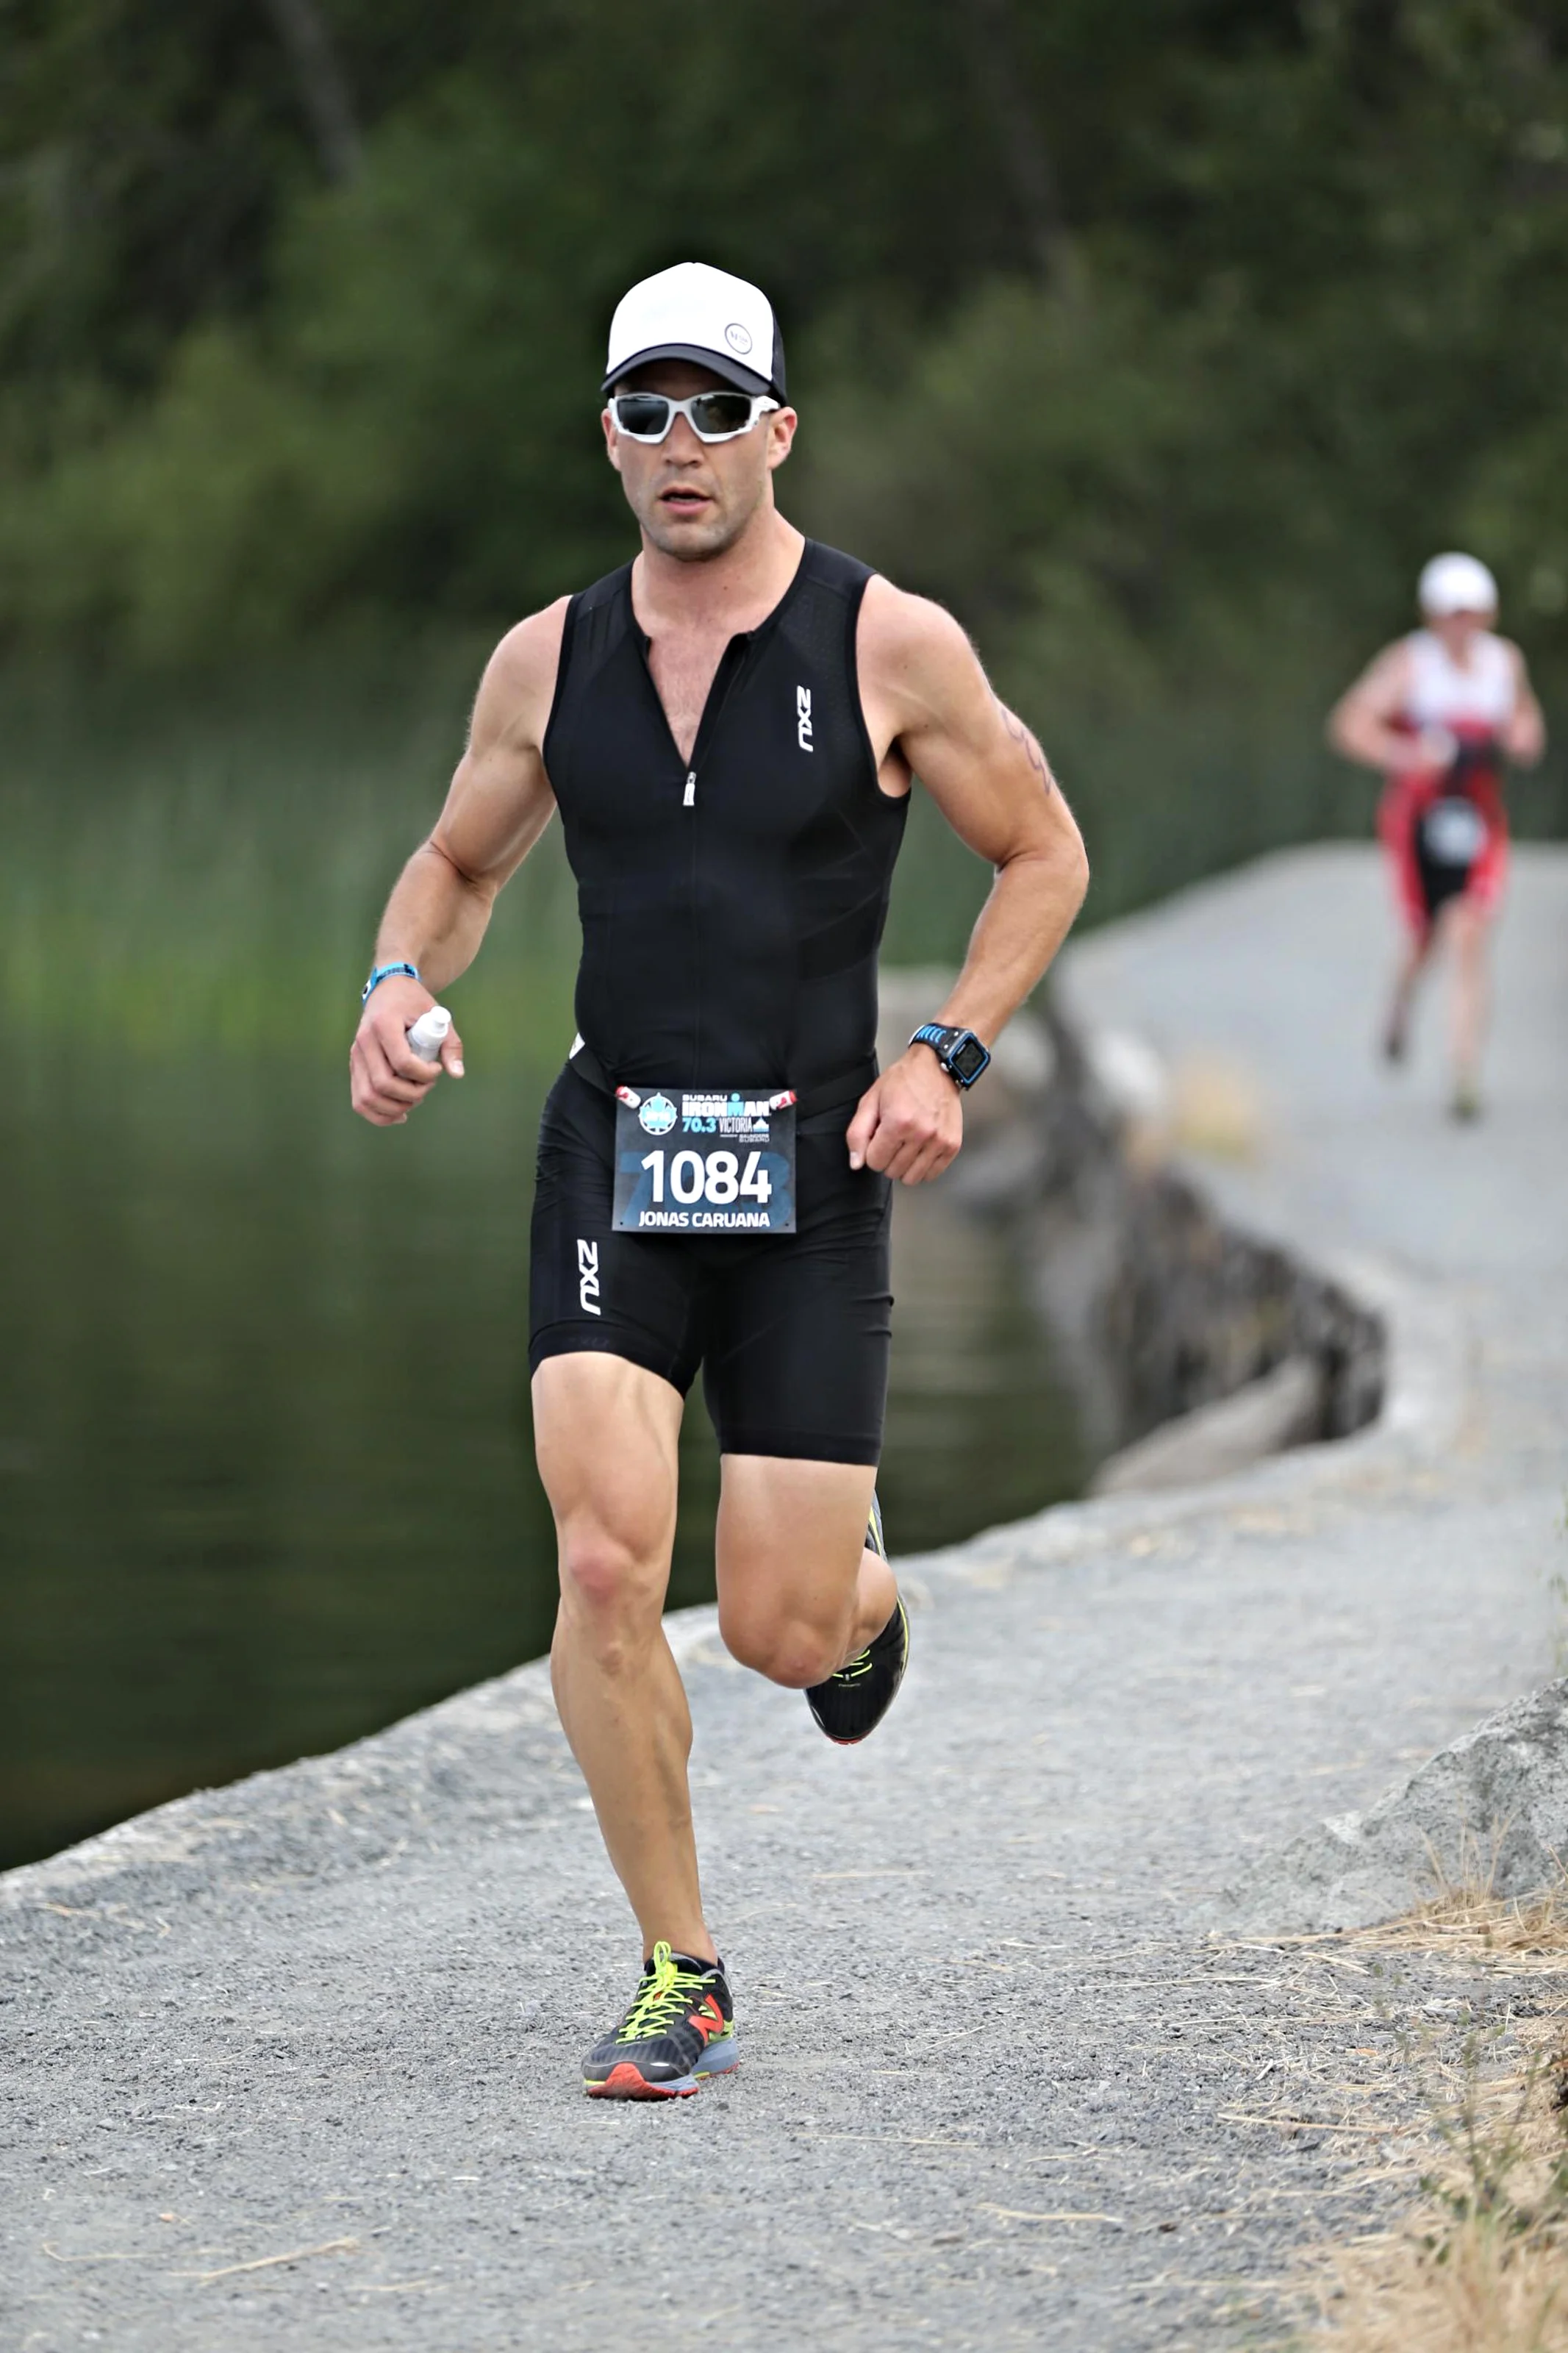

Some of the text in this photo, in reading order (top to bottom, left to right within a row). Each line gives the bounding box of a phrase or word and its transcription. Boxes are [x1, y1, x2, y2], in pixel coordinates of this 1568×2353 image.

[797, 685, 814, 752] 2XU
[682, 1101, 770, 1117] IRONMAN
[682, 1117, 753, 1133] 70.3 VICTORIA
[641, 1150, 772, 1204] 1084
[639, 1212, 770, 1228] JONAS CARUANA
[577, 1239, 601, 1315] 2XU
